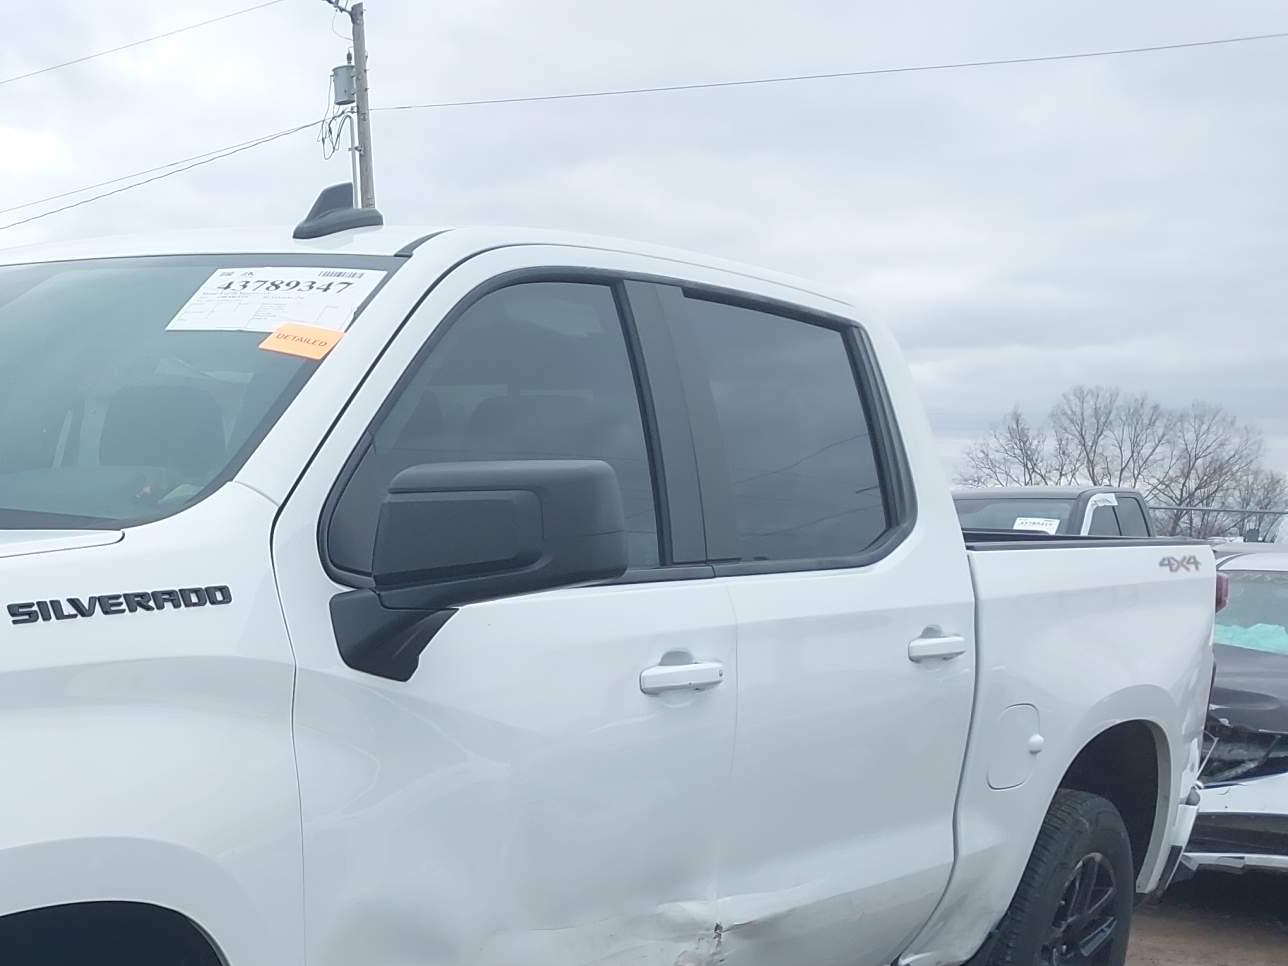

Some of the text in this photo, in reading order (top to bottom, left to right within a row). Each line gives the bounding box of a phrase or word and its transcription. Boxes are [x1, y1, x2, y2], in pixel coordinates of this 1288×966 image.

[217, 279, 353, 294] 43789347
[275, 332, 328, 348] DETAILED
[7, 585, 232, 625] SILVERADO
